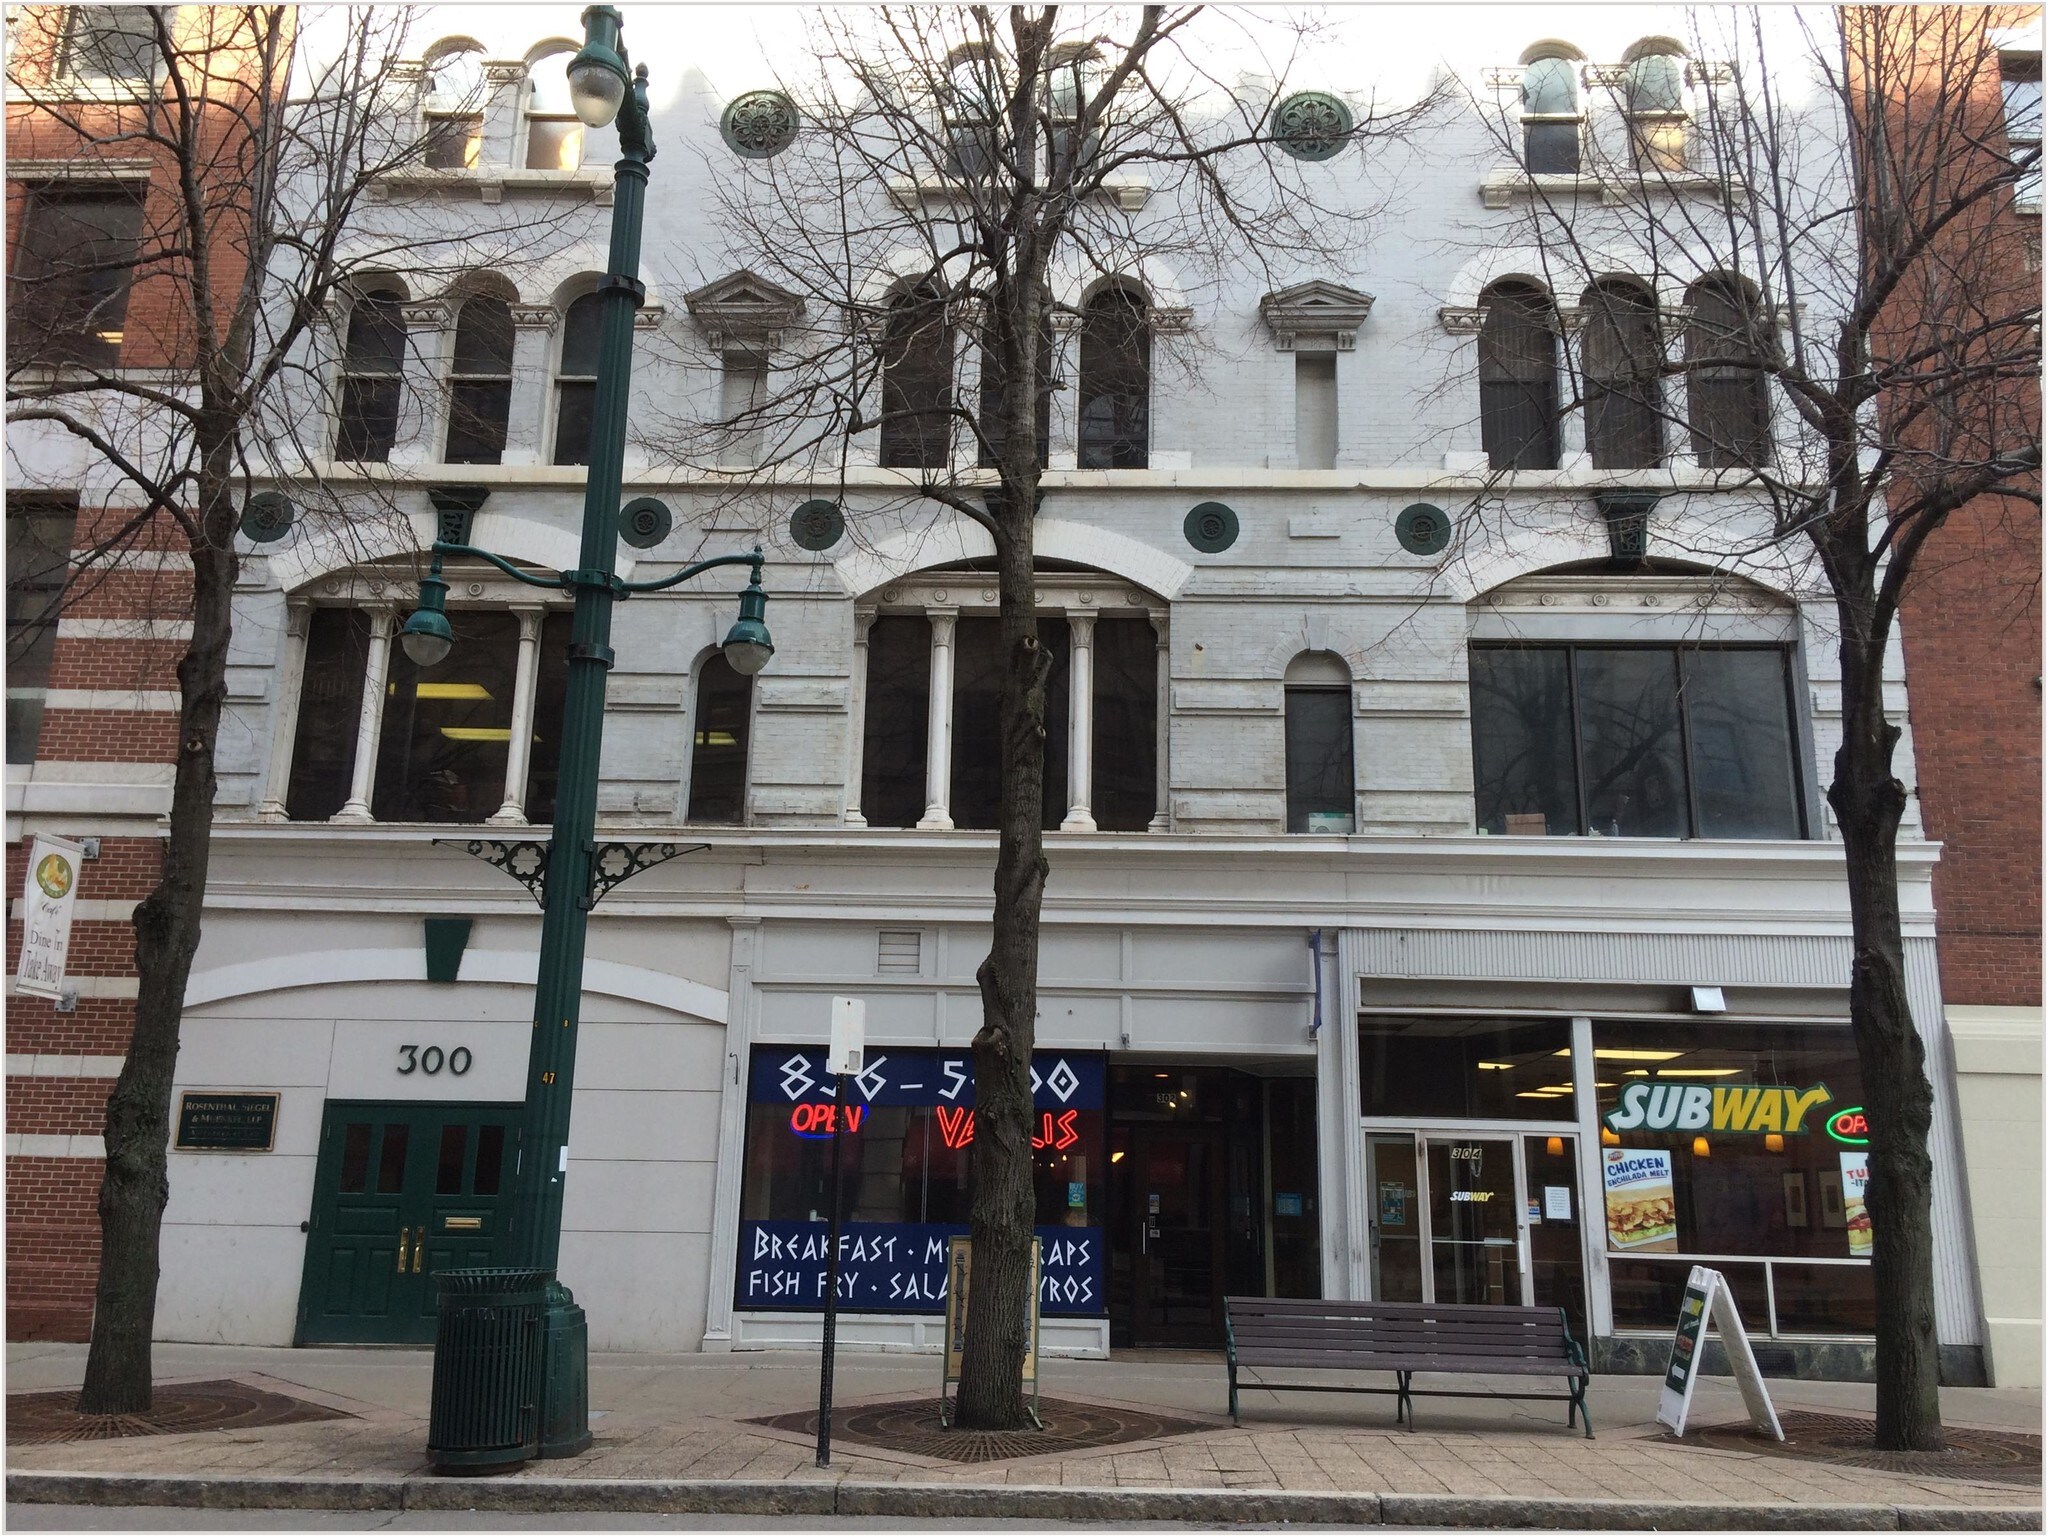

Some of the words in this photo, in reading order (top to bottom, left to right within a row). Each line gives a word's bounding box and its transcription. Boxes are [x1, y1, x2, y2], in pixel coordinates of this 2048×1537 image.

[30, 929, 52, 949] Dine
[23, 950, 41, 981] Take
[41, 956, 62, 990] Away
[397, 1045, 472, 1075] 300
[542, 1072, 556, 1084] 47
[1607, 1084, 1831, 1132] SUBWAY
[1451, 1148, 1482, 1159] 304
[1608, 1157, 1664, 1176] CHICKEN
[1607, 1171, 1647, 1187] ENCHILADA
[1450, 1191, 1495, 1202] SUBWAY
[753, 1226, 898, 1262] BREAKFAST
[749, 1269, 801, 1297] FISH
[1038, 1275, 1094, 1304] YROS
